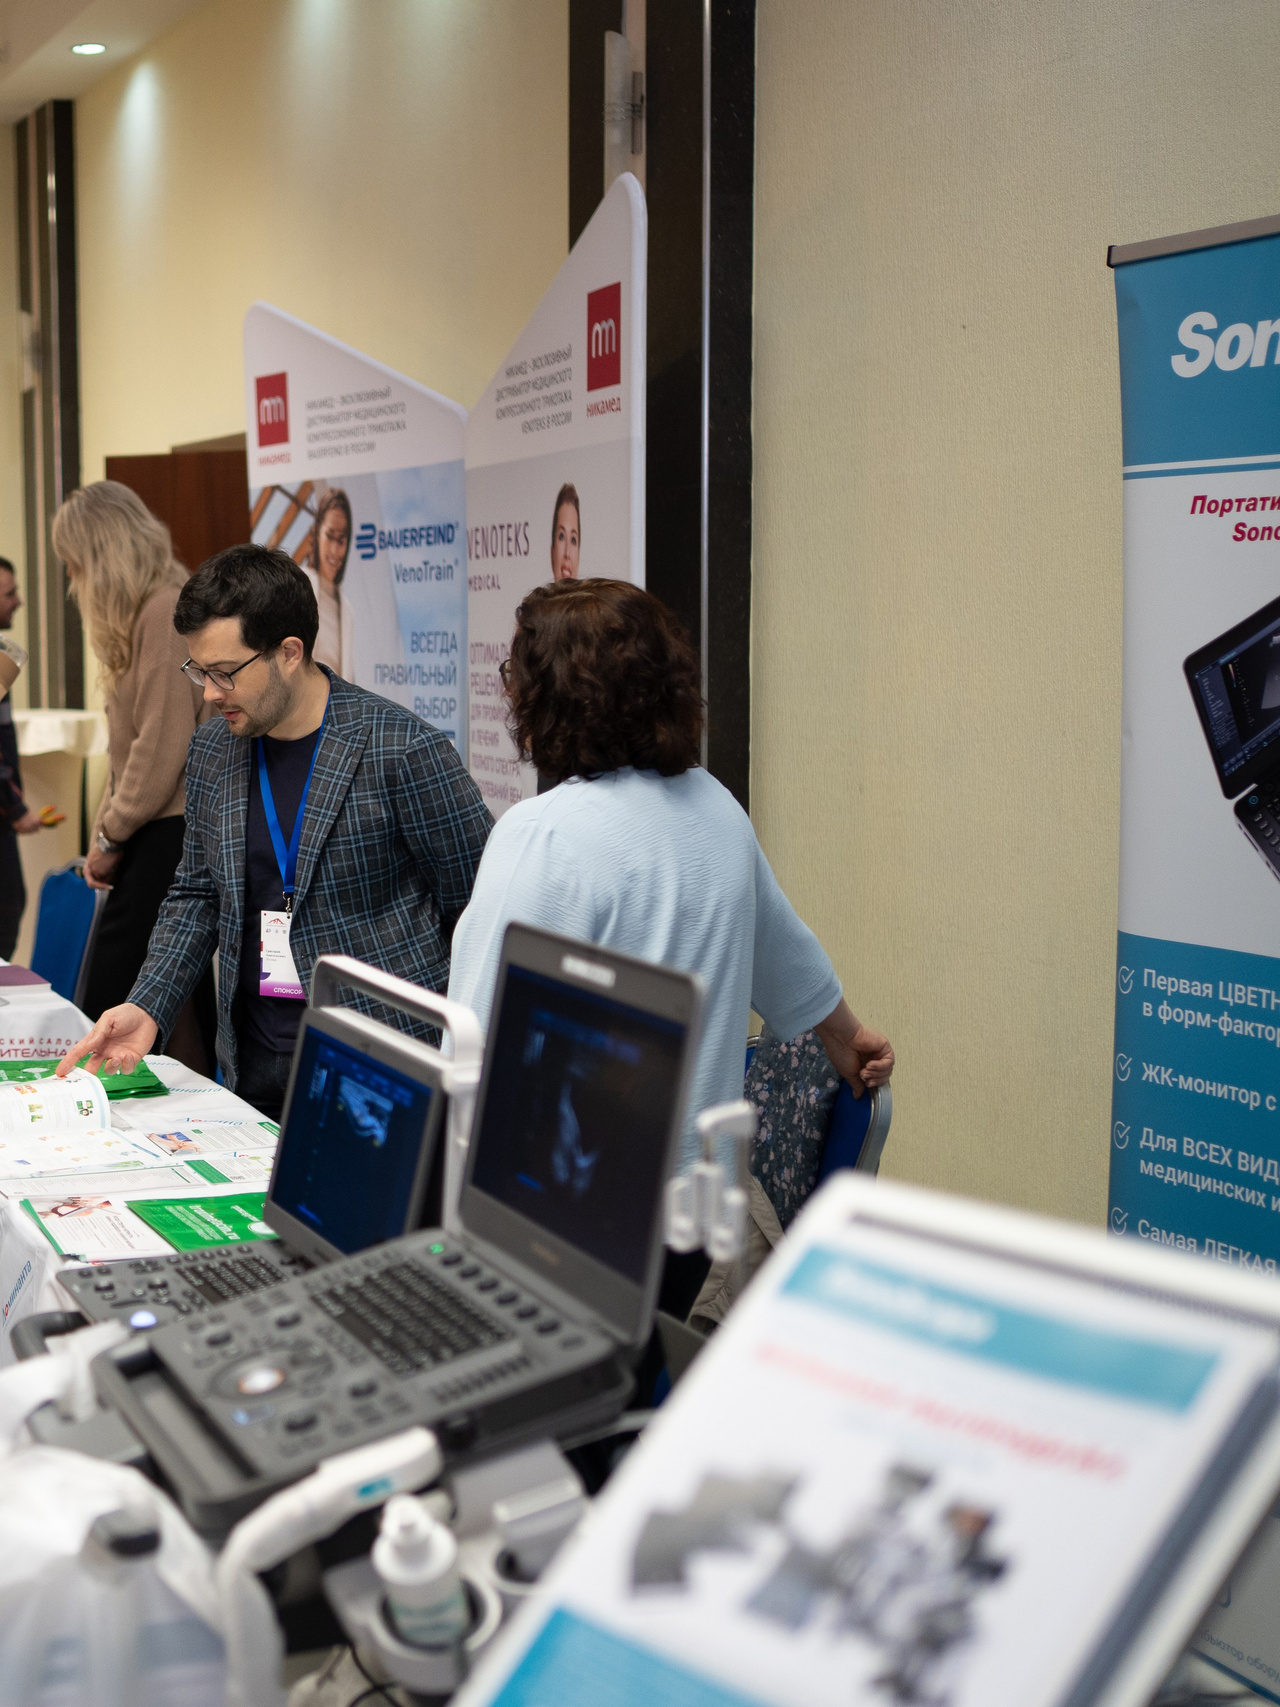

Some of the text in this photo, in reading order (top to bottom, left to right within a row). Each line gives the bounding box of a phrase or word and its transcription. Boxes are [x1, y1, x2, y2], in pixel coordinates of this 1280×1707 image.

[1171, 311, 1280, 378] Son
[467, 522, 530, 560] VENOTEKS
[411, 631, 458, 657] ВСЕГДА
[375, 661, 457, 686] ПРАВИЛЬНЫЙ
[414, 696, 457, 719] ВЫБОР
[273, 987, 302, 995] СПОНСОР
[1144, 968, 1213, 998] Первая
[1142, 1001, 1153, 1017] в
[1142, 1062, 1277, 1111] ЖК-монитор с
[1140, 1127, 1280, 1186] Для ВСЕХ ВИД
[1140, 1159, 1267, 1208] медицинских
[1138, 1219, 1277, 1279] Самая ЛЕГКАЯ
[2, 1260, 32, 1326] Доминанта
